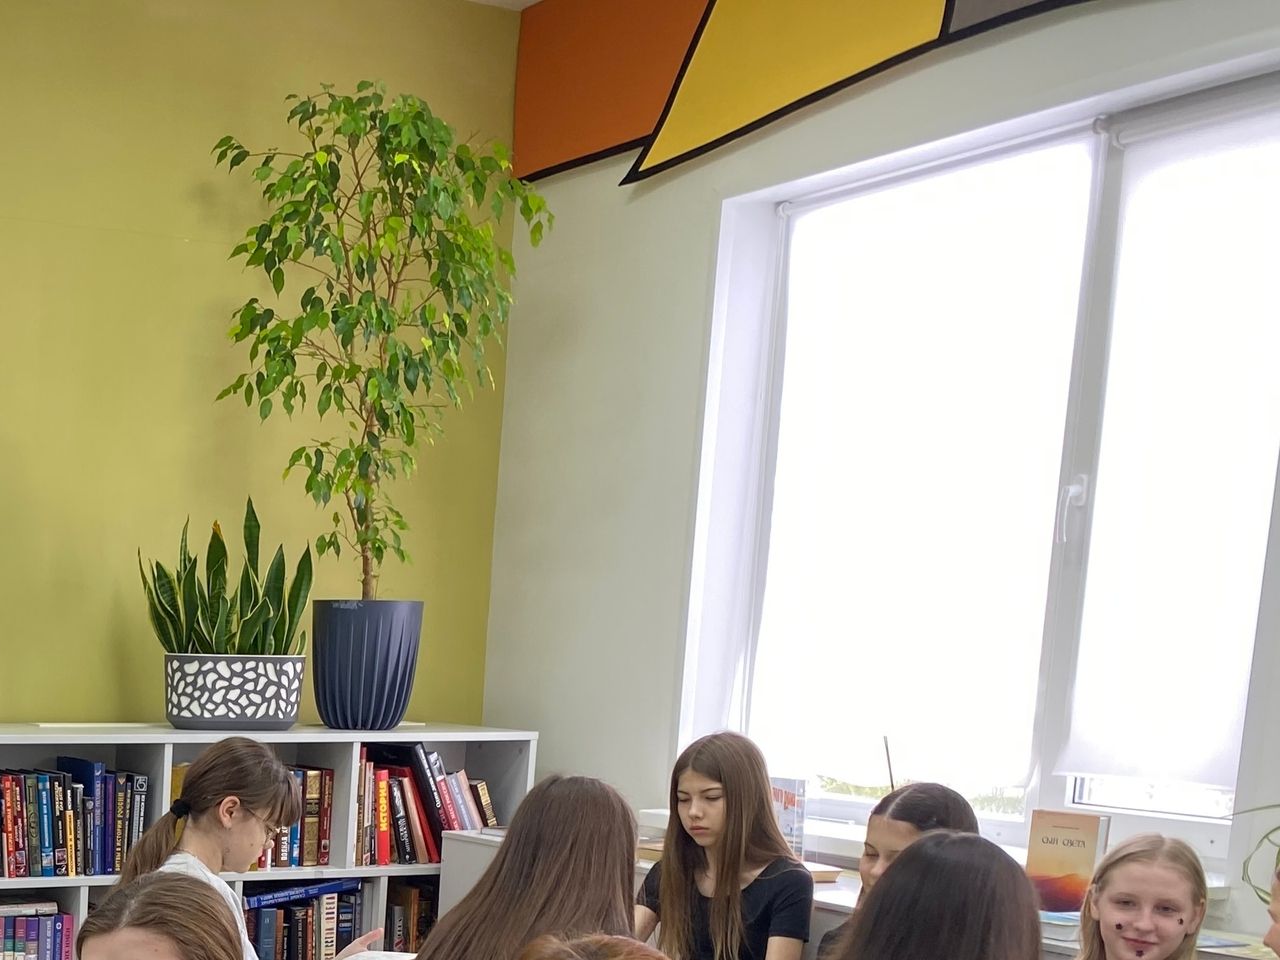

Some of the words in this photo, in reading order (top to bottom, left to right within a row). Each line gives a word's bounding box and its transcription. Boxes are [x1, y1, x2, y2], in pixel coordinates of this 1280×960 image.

[117, 792, 125, 818] РОССИИ
[379, 780, 388, 832] ИСТОРИЯ
[1063, 838, 1086, 849] СВЕТА
